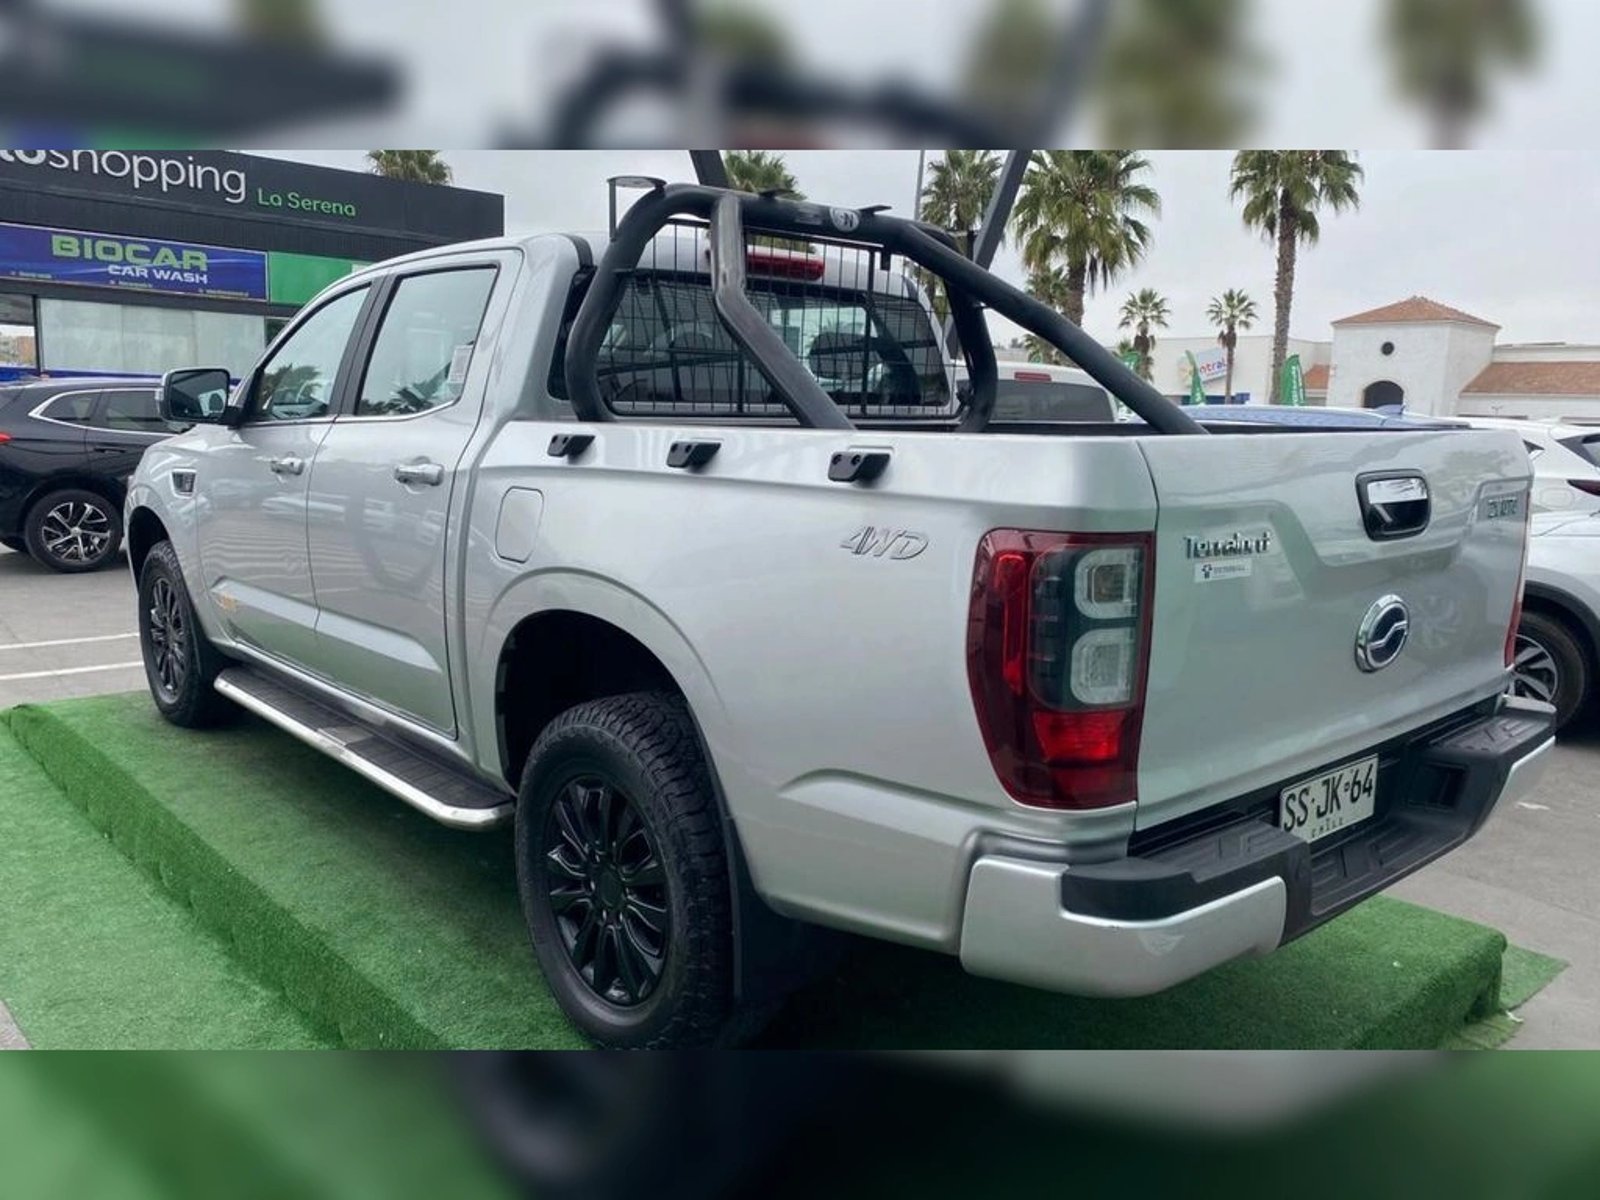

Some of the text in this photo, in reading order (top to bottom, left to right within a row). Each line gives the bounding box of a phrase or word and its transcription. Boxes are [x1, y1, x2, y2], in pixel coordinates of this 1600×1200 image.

[257, 187, 357, 217] La Serena
[51, 234, 208, 272] BIOCAR
[107, 264, 149, 279] CAR
[151, 268, 208, 285] WASH
[839, 525, 930, 561] 4WD
